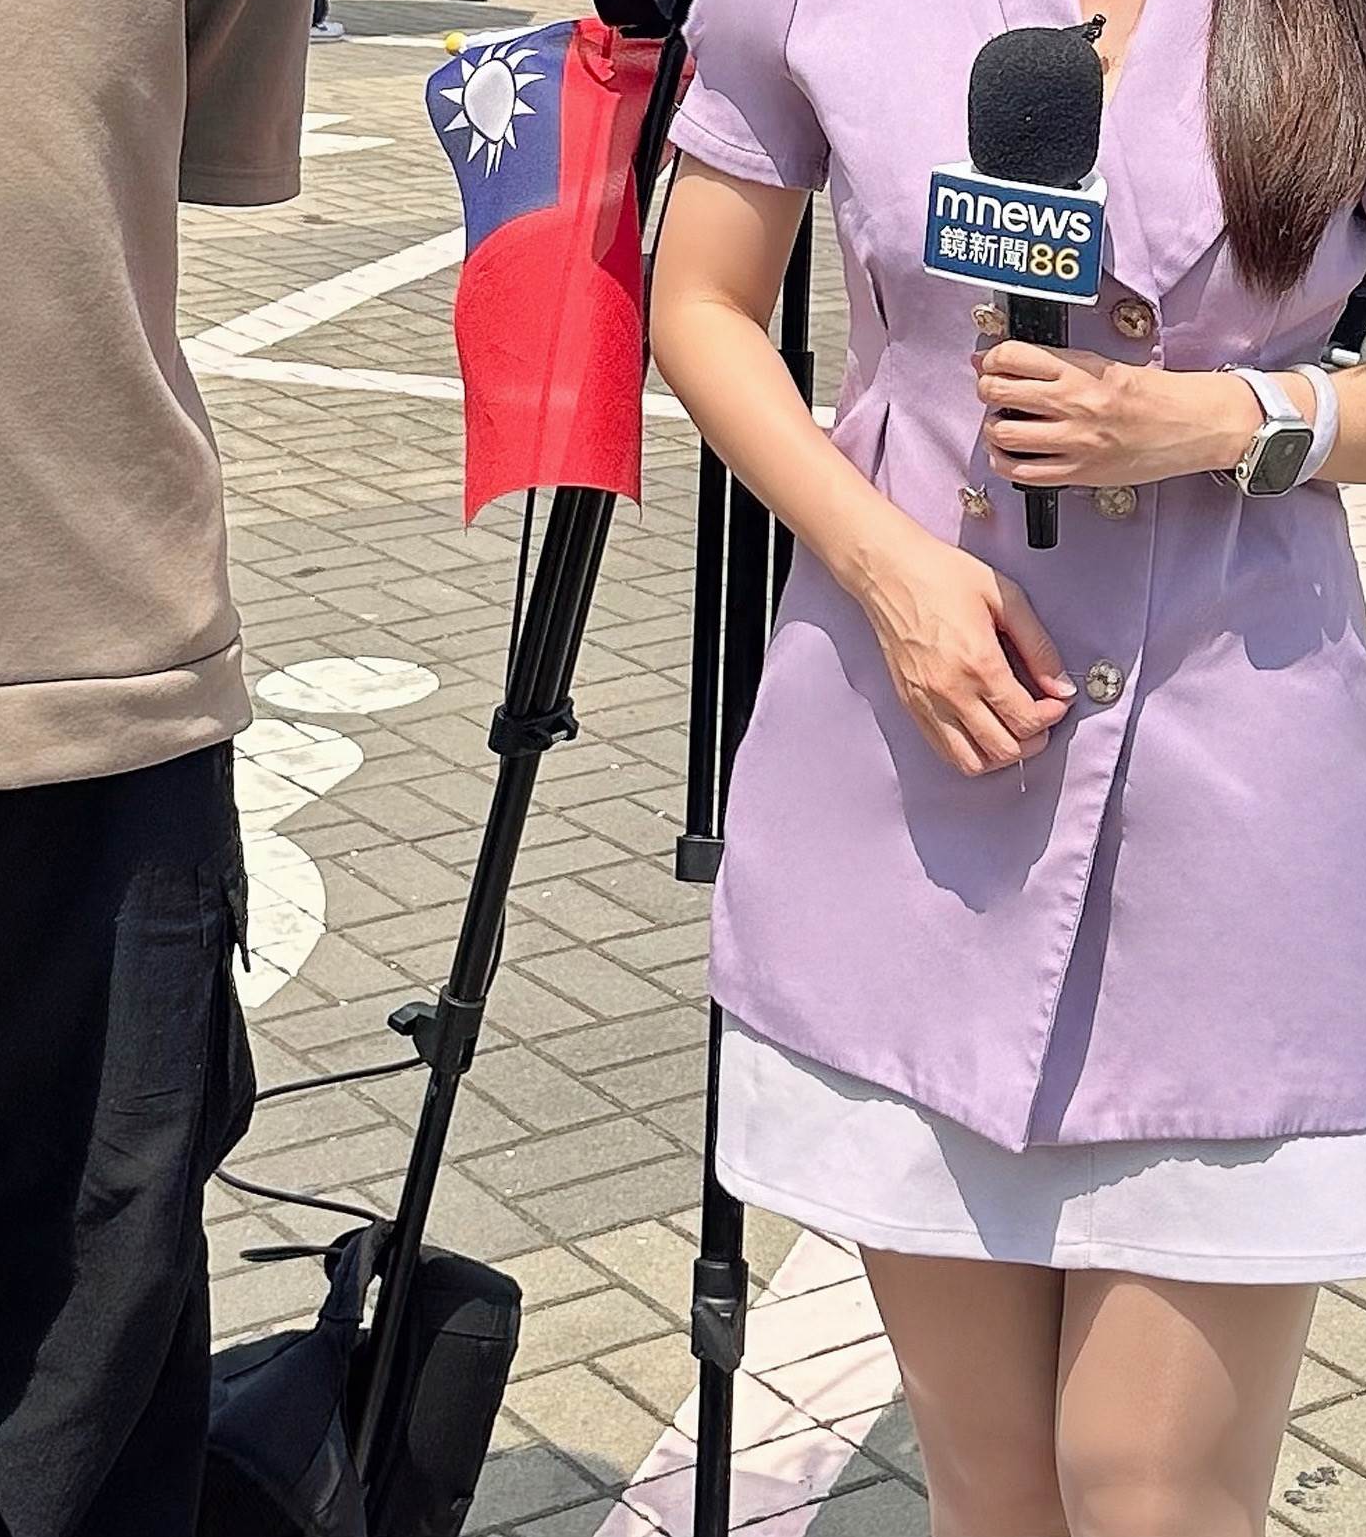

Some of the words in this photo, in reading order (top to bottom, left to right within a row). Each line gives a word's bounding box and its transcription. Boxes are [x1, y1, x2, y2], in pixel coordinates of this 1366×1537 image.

[935, 185, 1093, 244] mnews
[939, 225, 1081, 281] 鏡新聞86
